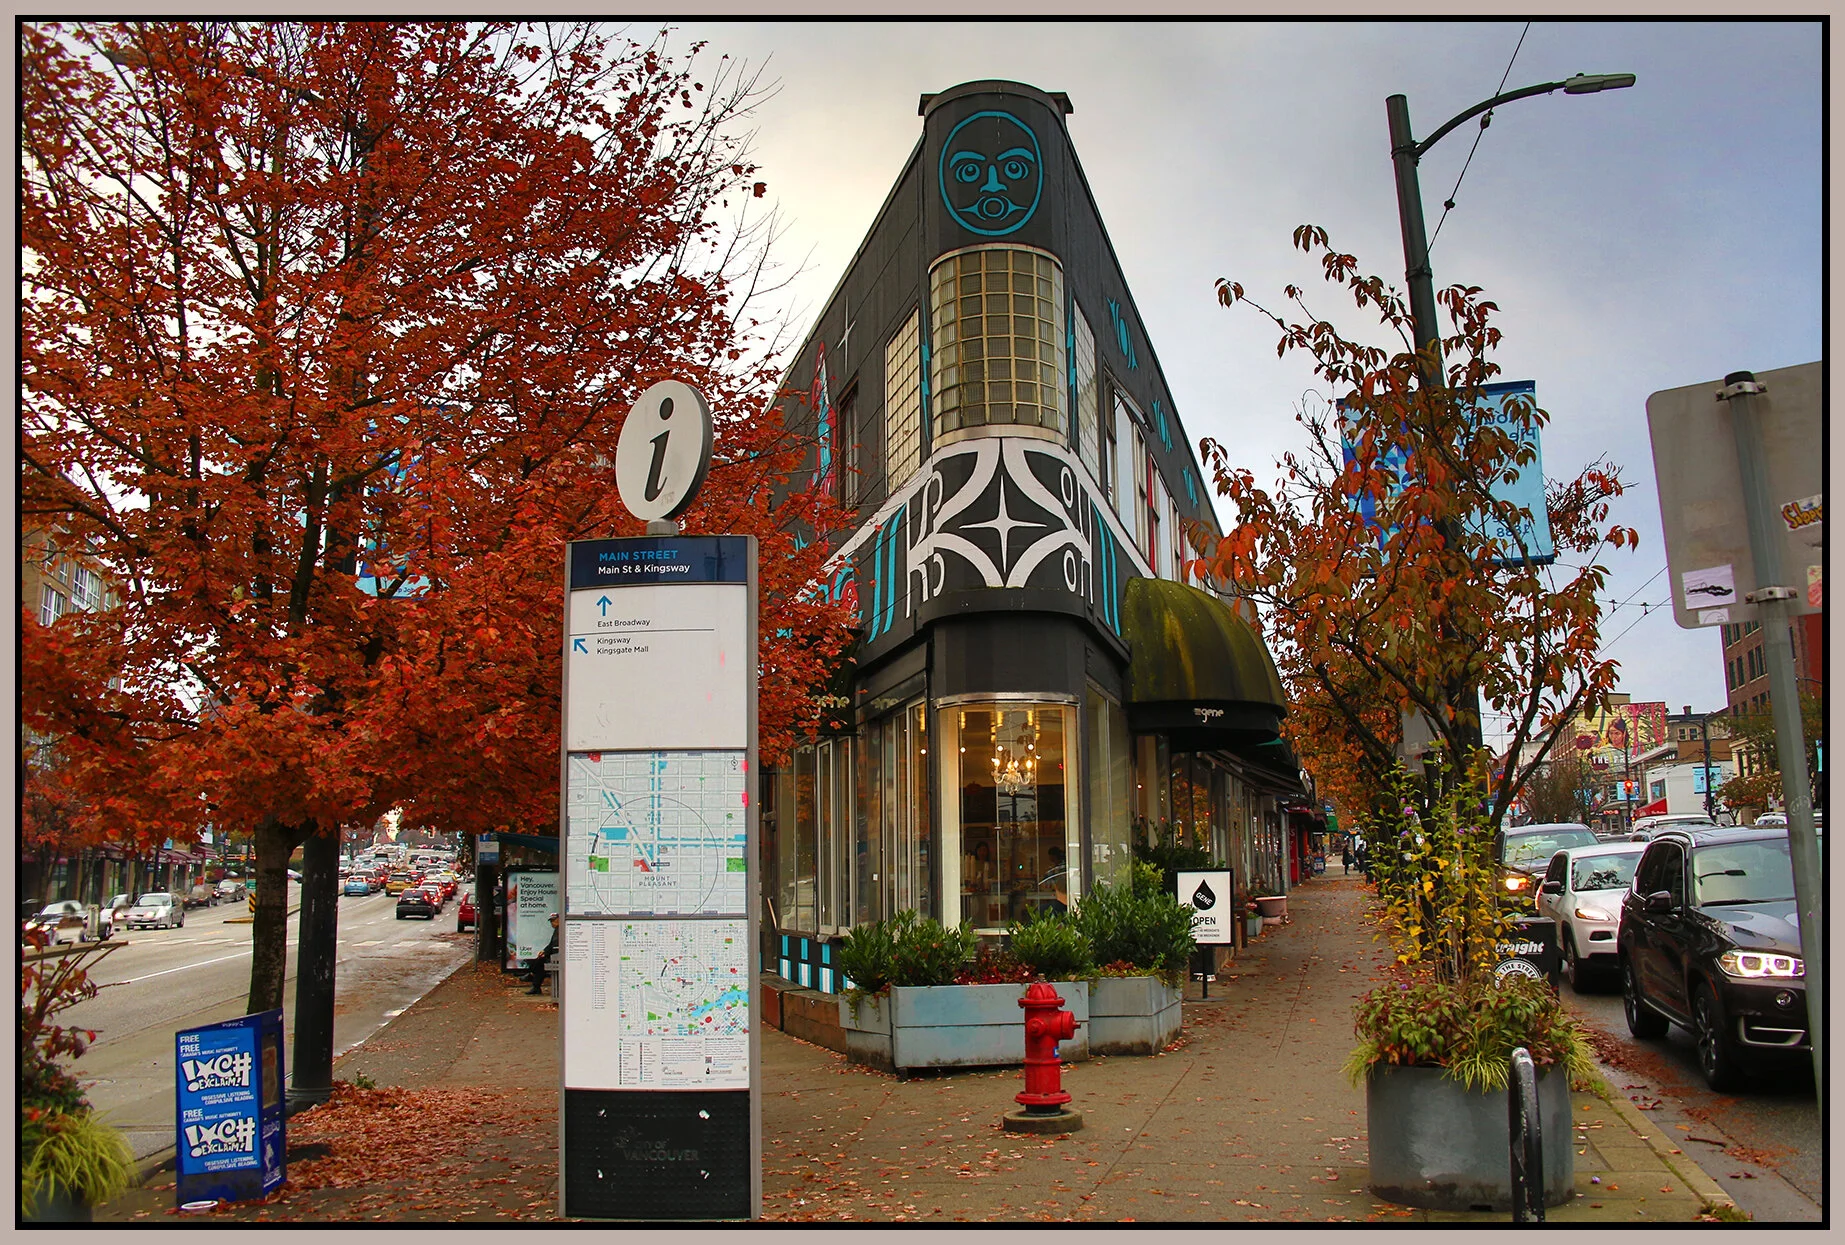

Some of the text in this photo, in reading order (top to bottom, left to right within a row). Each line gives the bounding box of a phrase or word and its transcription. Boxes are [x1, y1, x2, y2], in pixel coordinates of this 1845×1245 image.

[599, 550, 678, 561] MAIN STREET
[598, 563, 690, 575] Main St & Kingsway
[597, 619, 651, 628] East Broadway
[597, 637, 631, 645] Kingsway
[596, 647, 632, 655] Kingsgate
[1195, 892, 1213, 906] GENE
[1192, 916, 1216, 925] OPEN
[1502, 963, 1515, 972] THE
[180, 1034, 200, 1043] FREE
[180, 1043, 200, 1053] FREE
[183, 1108, 203, 1119] FREE
[623, 1149, 700, 1162] VANCOUVER
